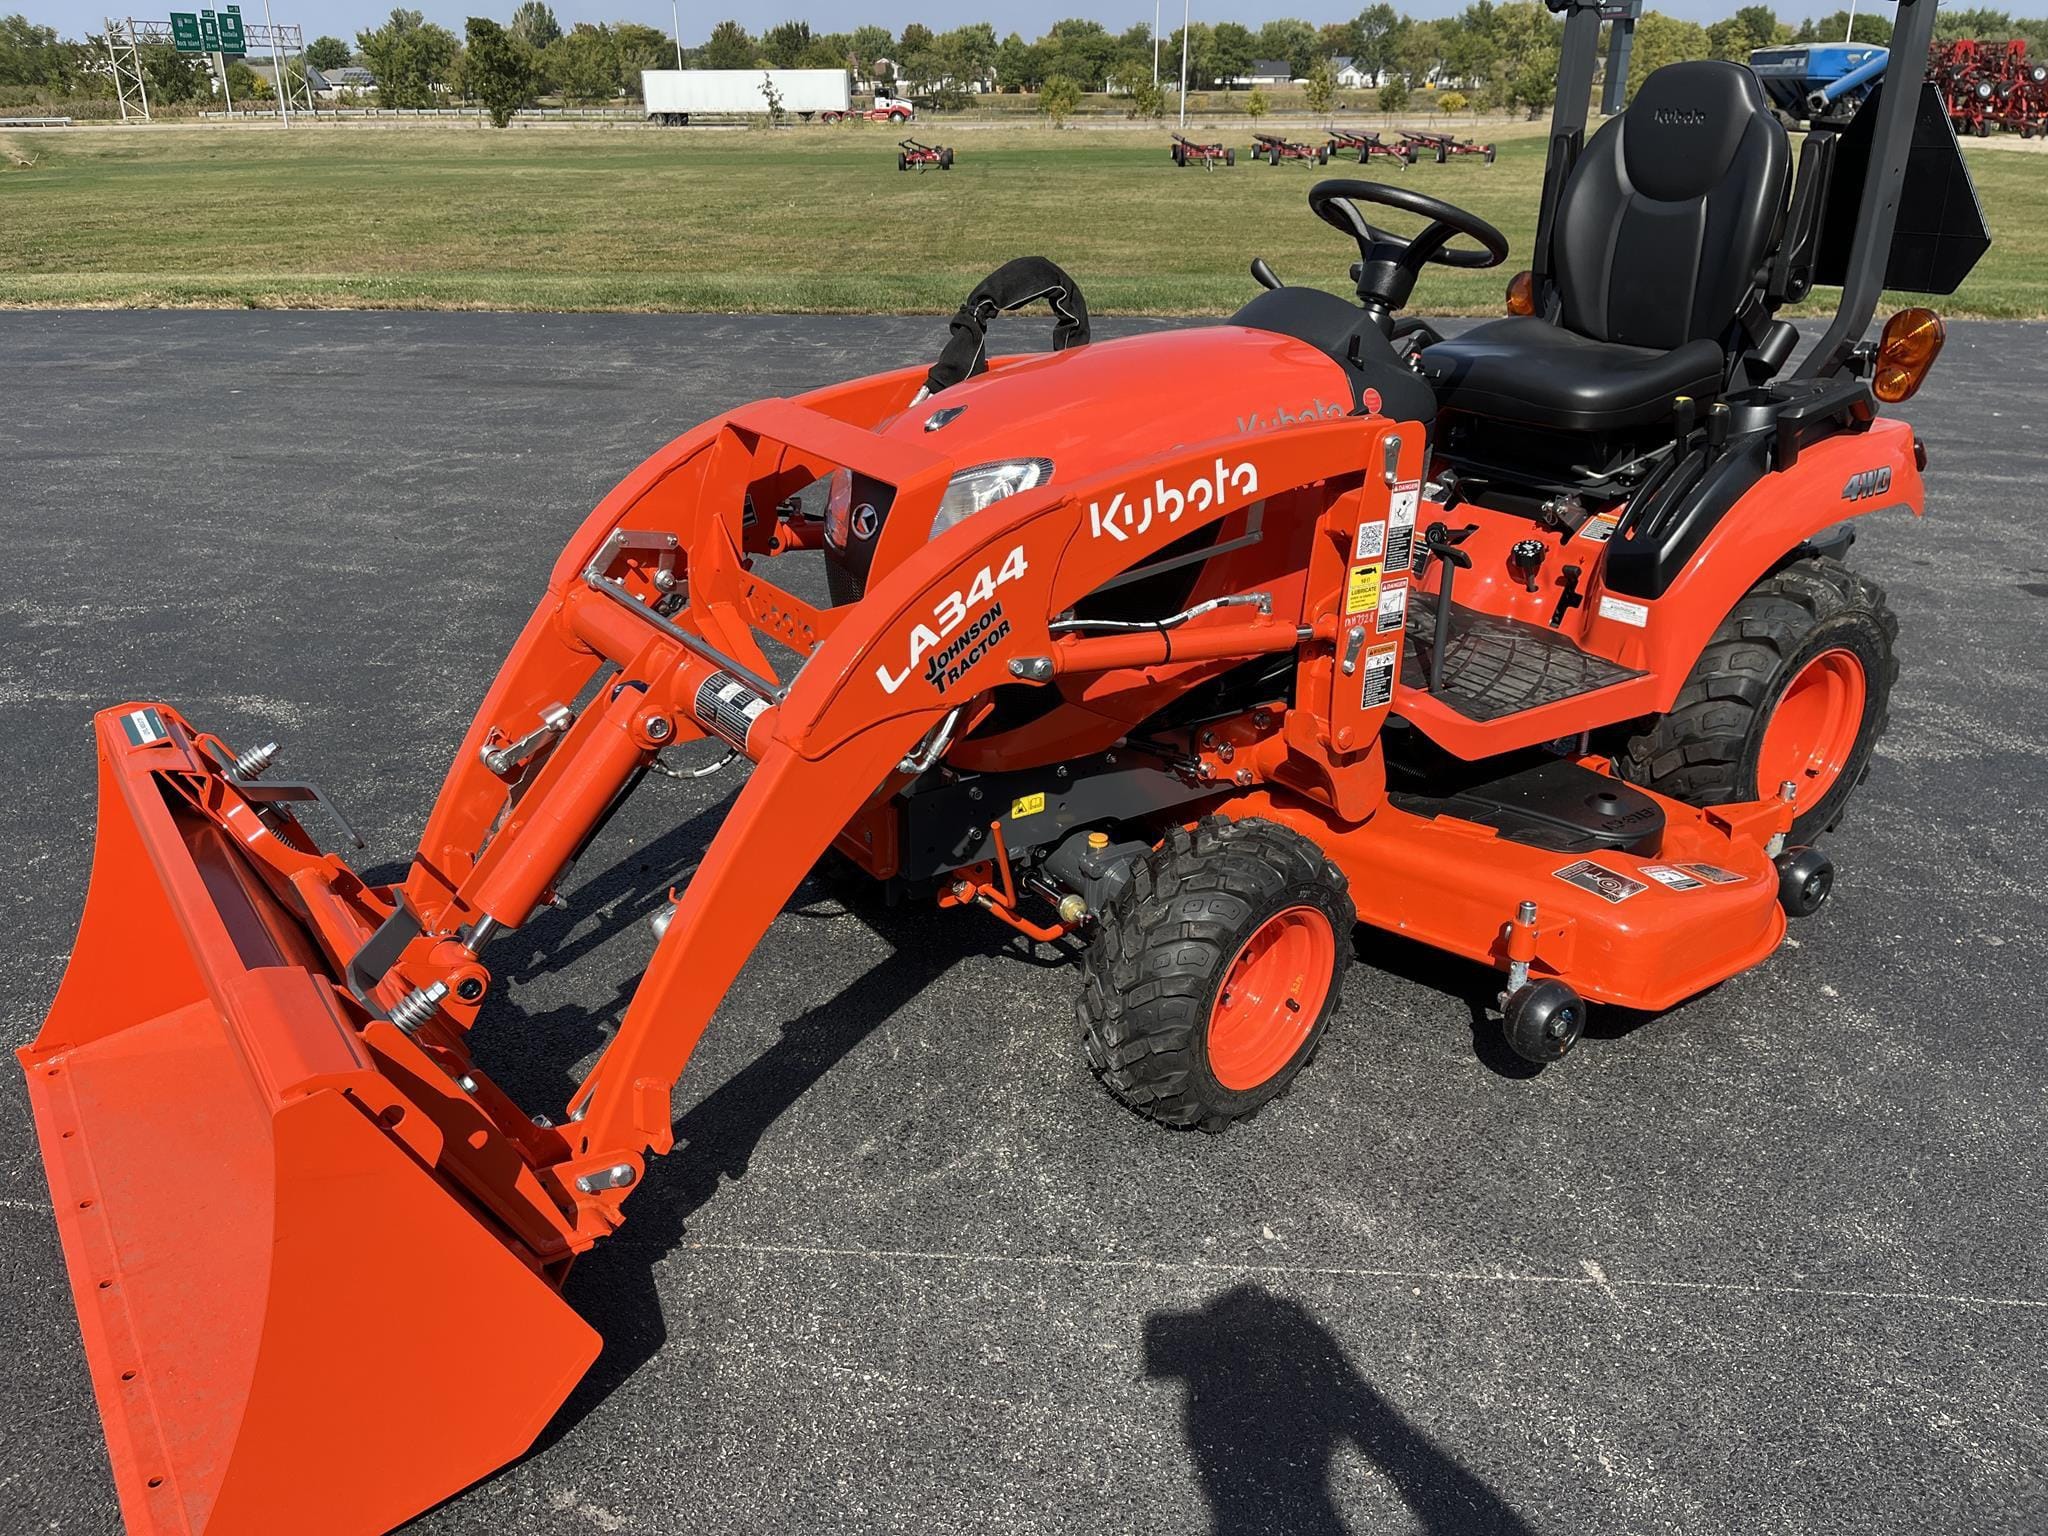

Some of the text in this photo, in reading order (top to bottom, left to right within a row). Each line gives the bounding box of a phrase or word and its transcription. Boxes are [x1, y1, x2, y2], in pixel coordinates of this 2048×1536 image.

[1654, 109, 1705, 125] Kubota
[1089, 457, 1258, 542] Kubota
[1398, 482, 1418, 491] DANGER
[1841, 465, 1892, 502] 4WD
[1351, 586, 1377, 596] LUBRICATE
[875, 545, 1029, 694] LA344
[924, 601, 1003, 682] JOHNSON
[931, 619, 1011, 694] TRACTOR
